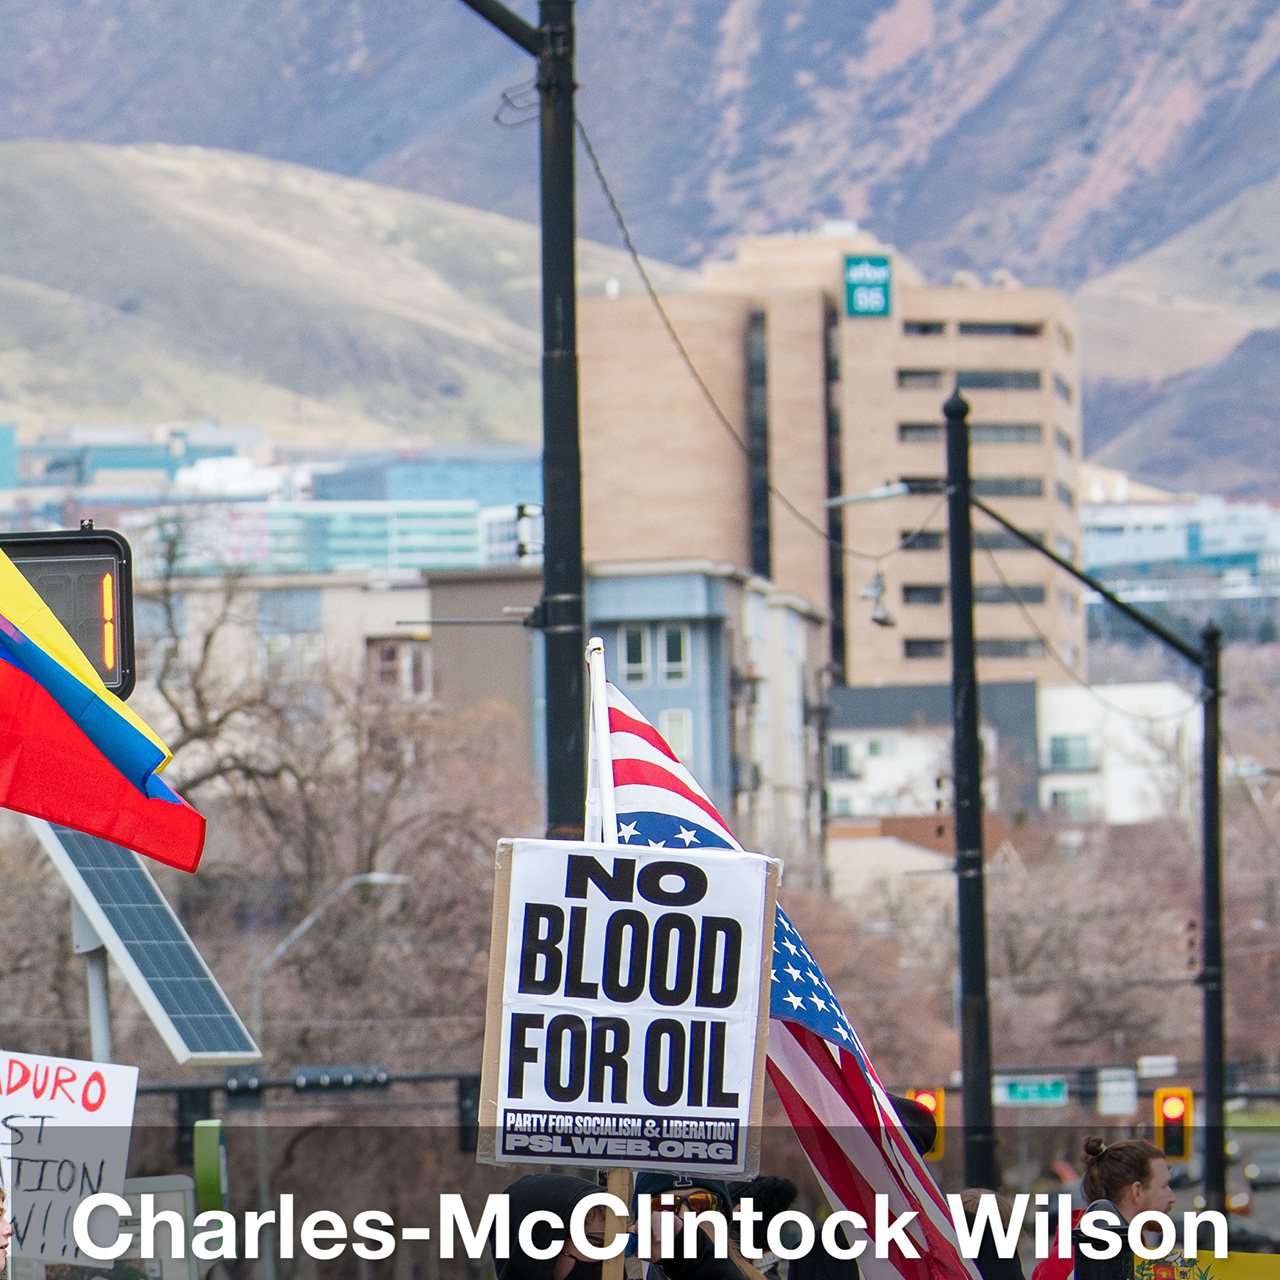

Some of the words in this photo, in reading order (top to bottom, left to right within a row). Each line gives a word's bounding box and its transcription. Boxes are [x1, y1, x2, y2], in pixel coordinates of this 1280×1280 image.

[564, 854, 708, 907] NO
[517, 902, 742, 1009] BLOOD
[506, 1012, 631, 1105] FOR
[642, 1017, 740, 1109] OIL
[505, 1133, 733, 1160] PSLWEB.ORG
[506, 1112, 548, 1133] PARTY
[548, 1113, 573, 1134] FOR
[575, 1115, 641, 1137] SOCIALISM
[643, 1119, 661, 1138] &
[662, 1119, 735, 1141] LIBERATION
